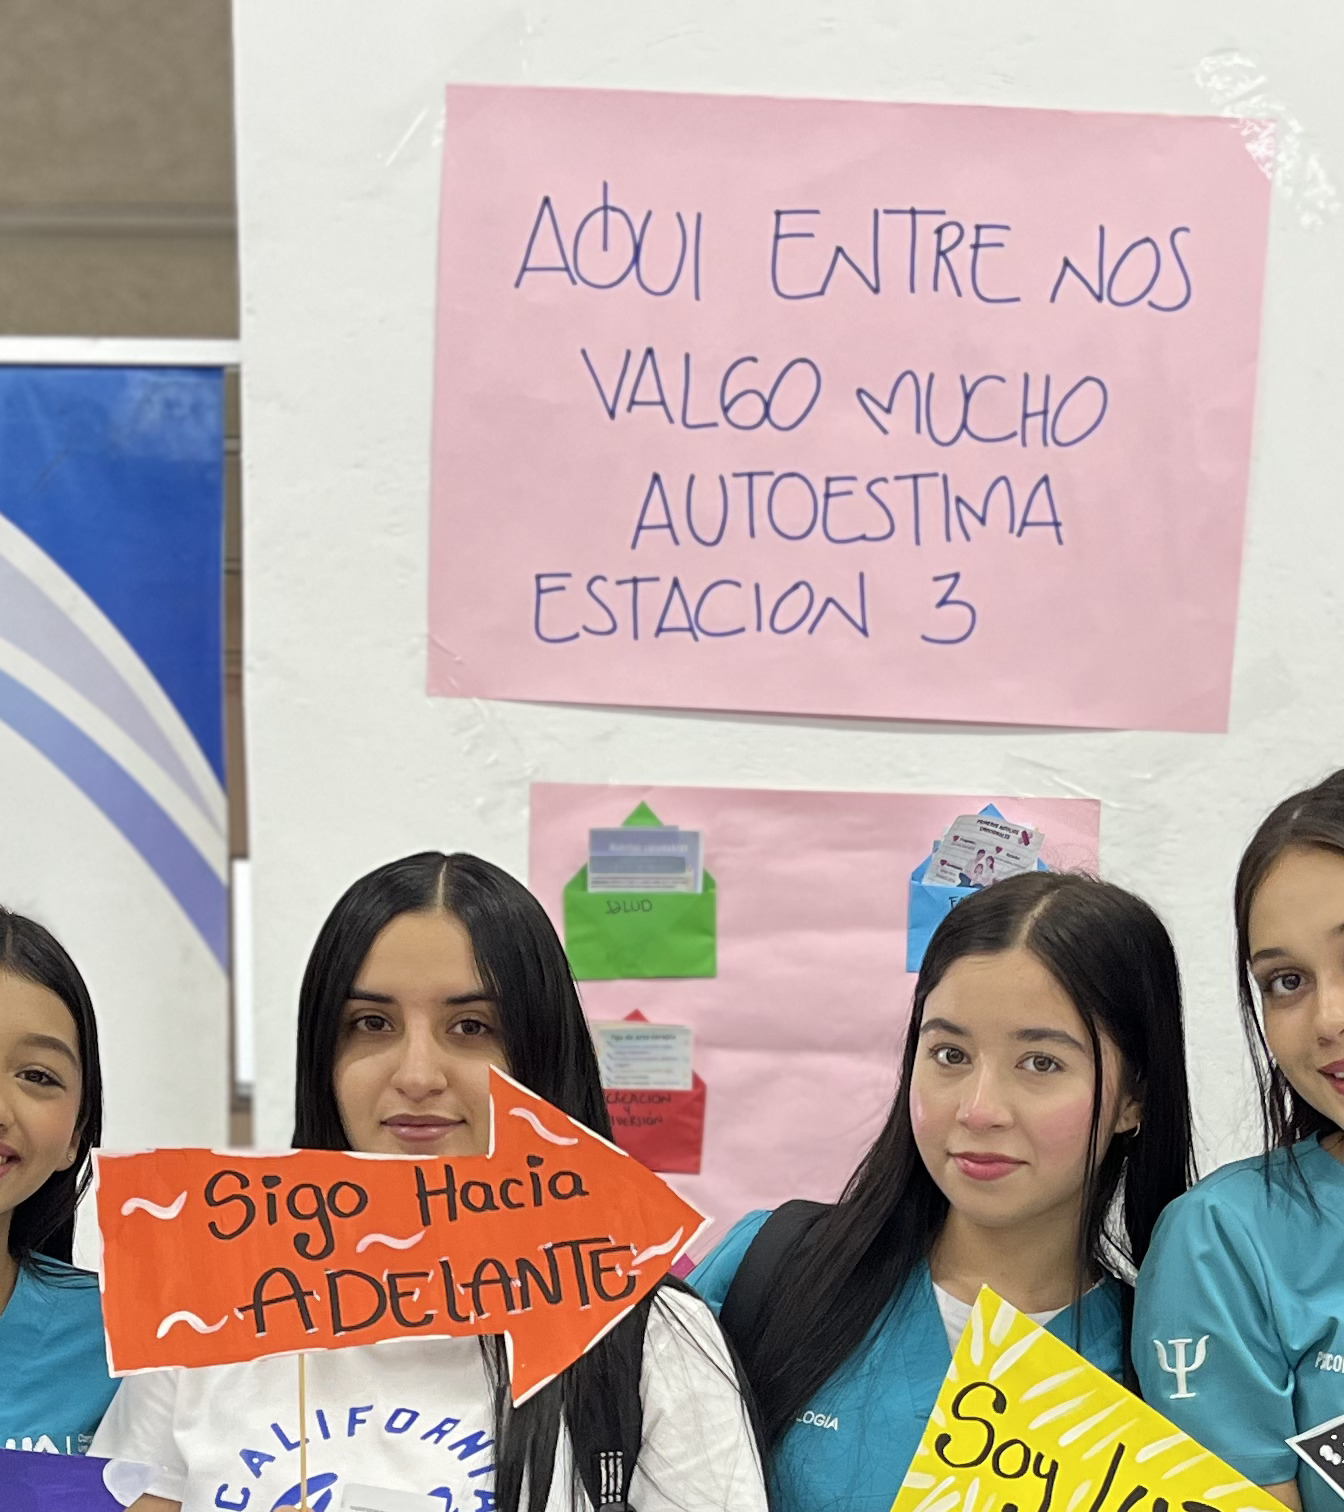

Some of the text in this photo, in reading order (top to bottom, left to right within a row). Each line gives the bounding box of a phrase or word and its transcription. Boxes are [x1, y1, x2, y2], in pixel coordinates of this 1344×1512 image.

[515, 180, 1192, 312] AQUI ENTRE NOS
[580, 346, 1109, 448] VALGO MUCHO
[630, 471, 1064, 550] AUTOESTIMA
[533, 571, 978, 645] ESTACION 3
[203, 1154, 591, 1262] Sigo Hacia
